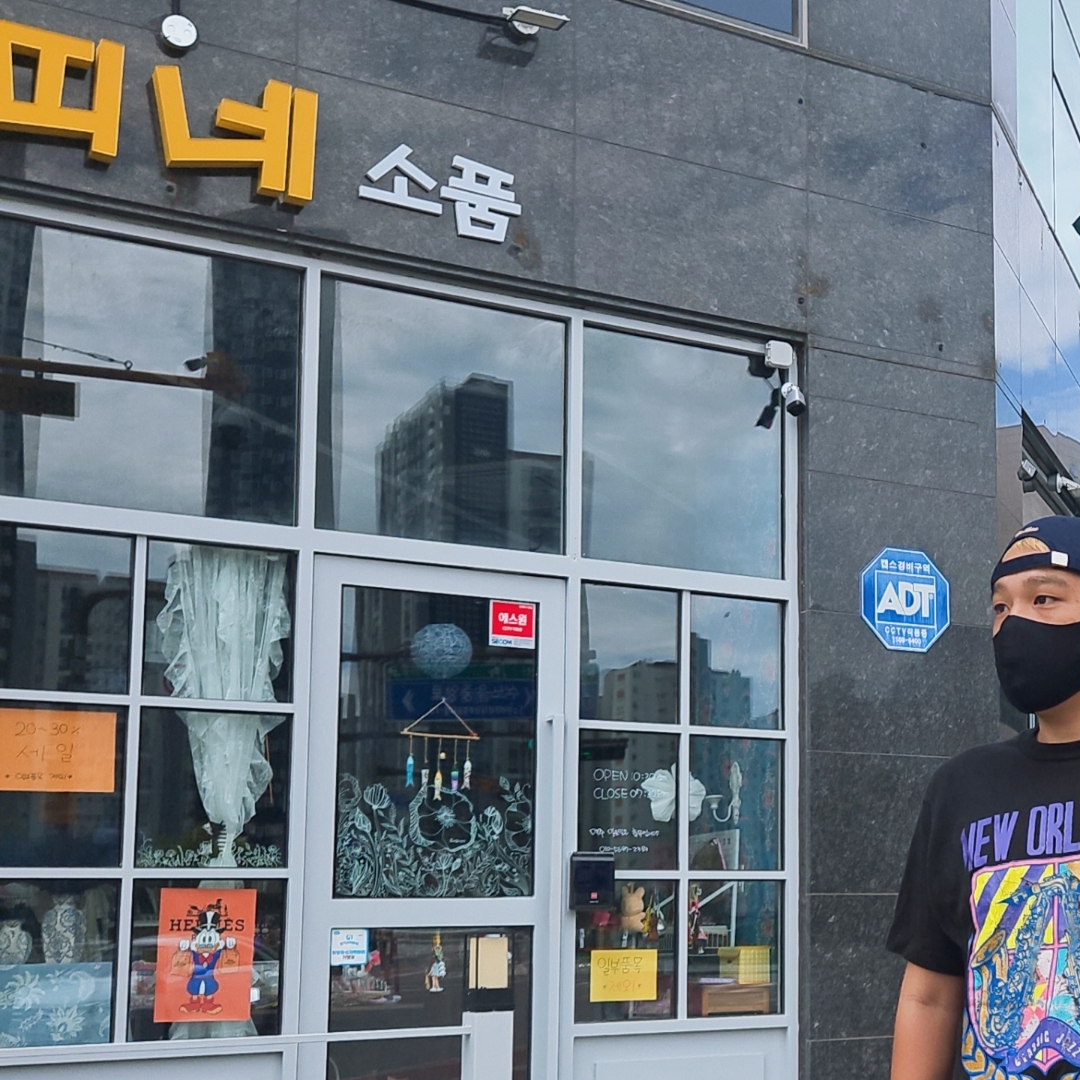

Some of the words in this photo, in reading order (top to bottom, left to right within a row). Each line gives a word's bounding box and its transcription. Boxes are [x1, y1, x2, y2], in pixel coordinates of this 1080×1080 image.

[358, 143, 521, 243] 소품
[876, 580, 934, 618] ADT
[498, 612, 528, 626] 에스원
[15, 721, 81, 736] 20~30%
[593, 768, 629, 781] OPEN
[593, 787, 629, 800] CLOSE
[960, 810, 1020, 872] NEW
[1014, 1030, 1050, 1067] CLASSIC
